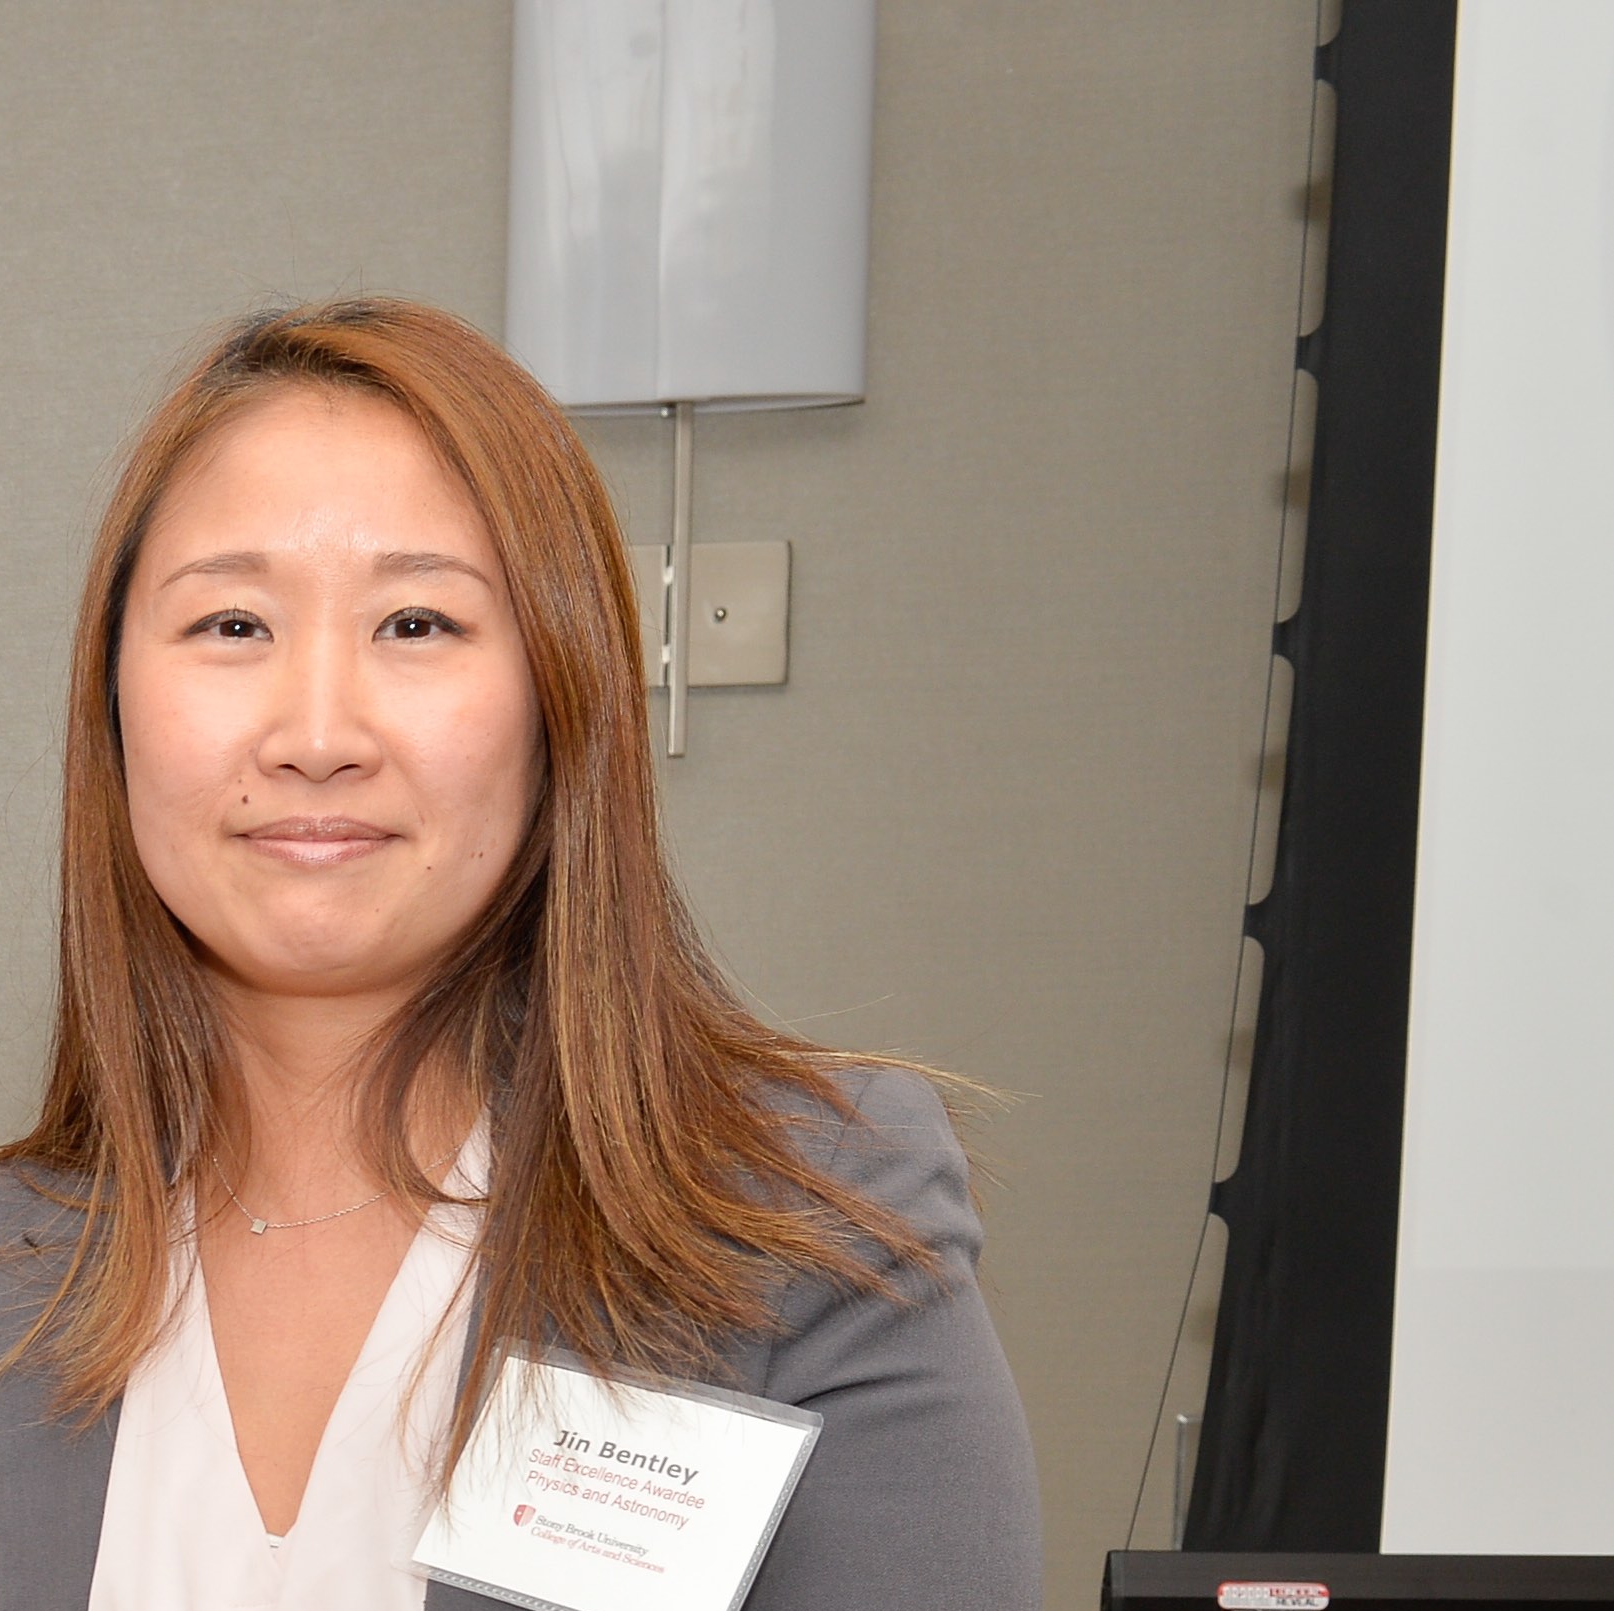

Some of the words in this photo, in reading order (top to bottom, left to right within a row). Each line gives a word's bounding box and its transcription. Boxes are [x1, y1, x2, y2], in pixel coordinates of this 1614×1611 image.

[528, 1448, 566, 1469] Staff
[562, 1456, 638, 1490] Excellence
[639, 1479, 705, 1510] Awardee
[553, 1430, 591, 1453] Jin
[598, 1441, 699, 1486] Bentley
[525, 1469, 580, 1496] Physics
[581, 1488, 611, 1505] and
[610, 1494, 690, 1531] Astronomy
[530, 1526, 567, 1545] College
[567, 1538, 582, 1550] of
[578, 1539, 602, 1555] Arts
[601, 1550, 623, 1561] and
[621, 1553, 665, 1574] Sciences
[535, 1514, 565, 1533] Stony
[564, 1523, 595, 1540] Brook
[596, 1531, 649, 1558] University
